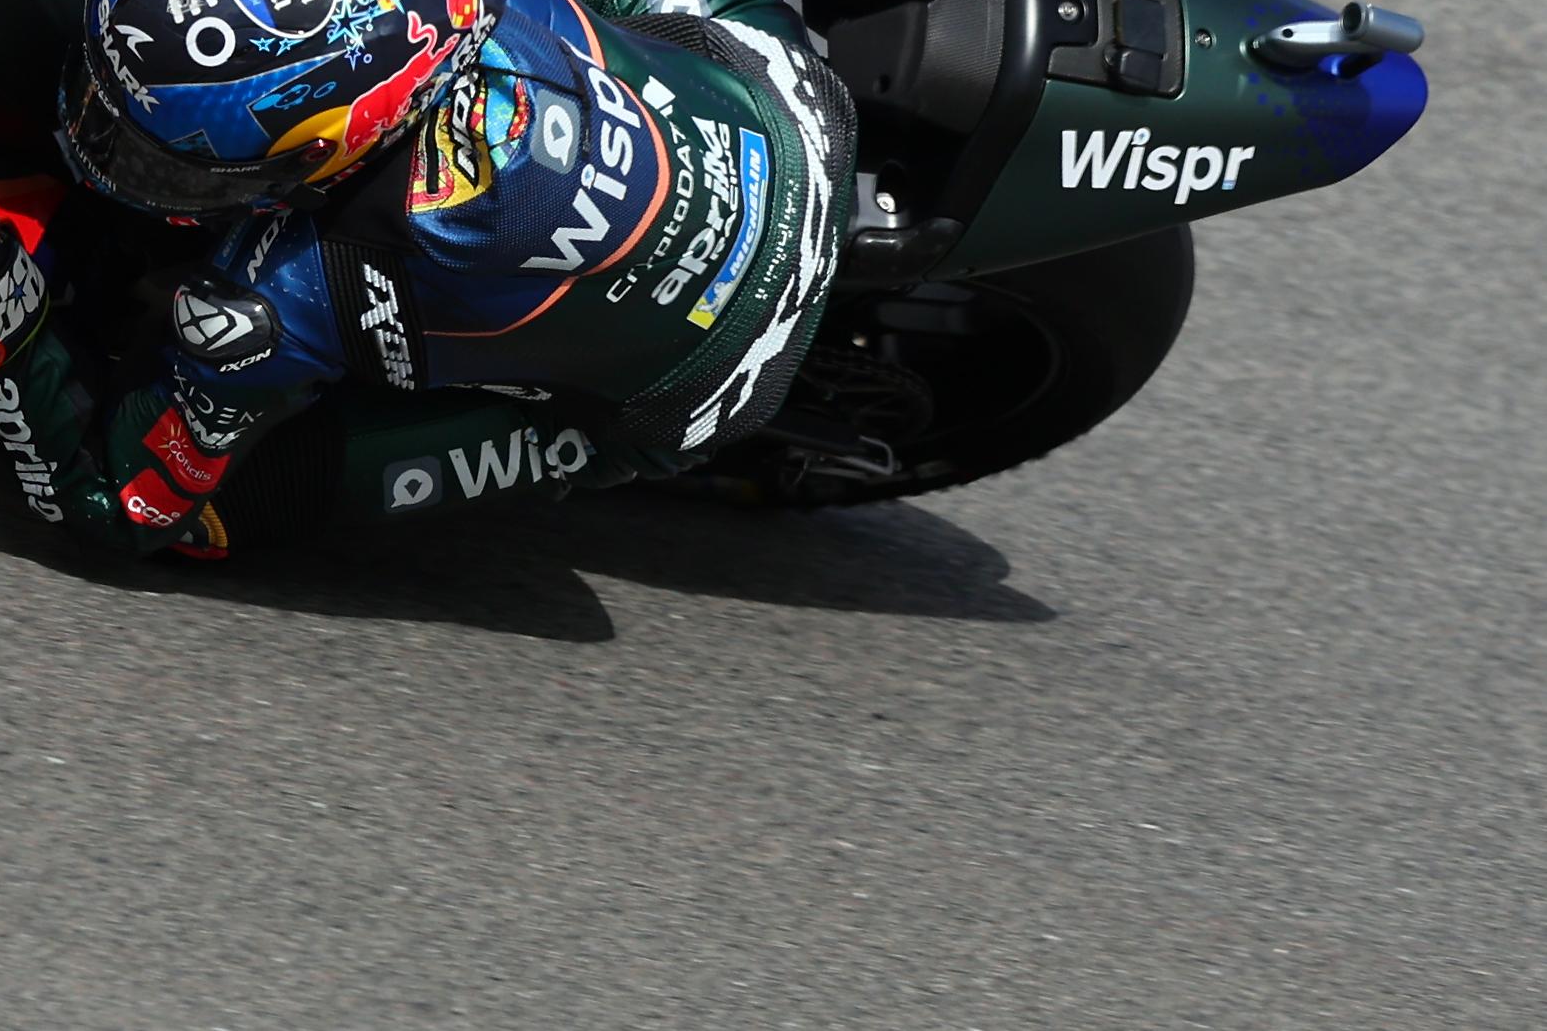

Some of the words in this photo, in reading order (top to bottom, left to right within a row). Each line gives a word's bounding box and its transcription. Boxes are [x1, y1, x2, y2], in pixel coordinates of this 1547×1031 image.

[521, 66, 641, 271] Wisp
[729, 148, 763, 277] MICHELIN
[1061, 127, 1255, 205] Wispr
[220, 348, 272, 373] IXON
